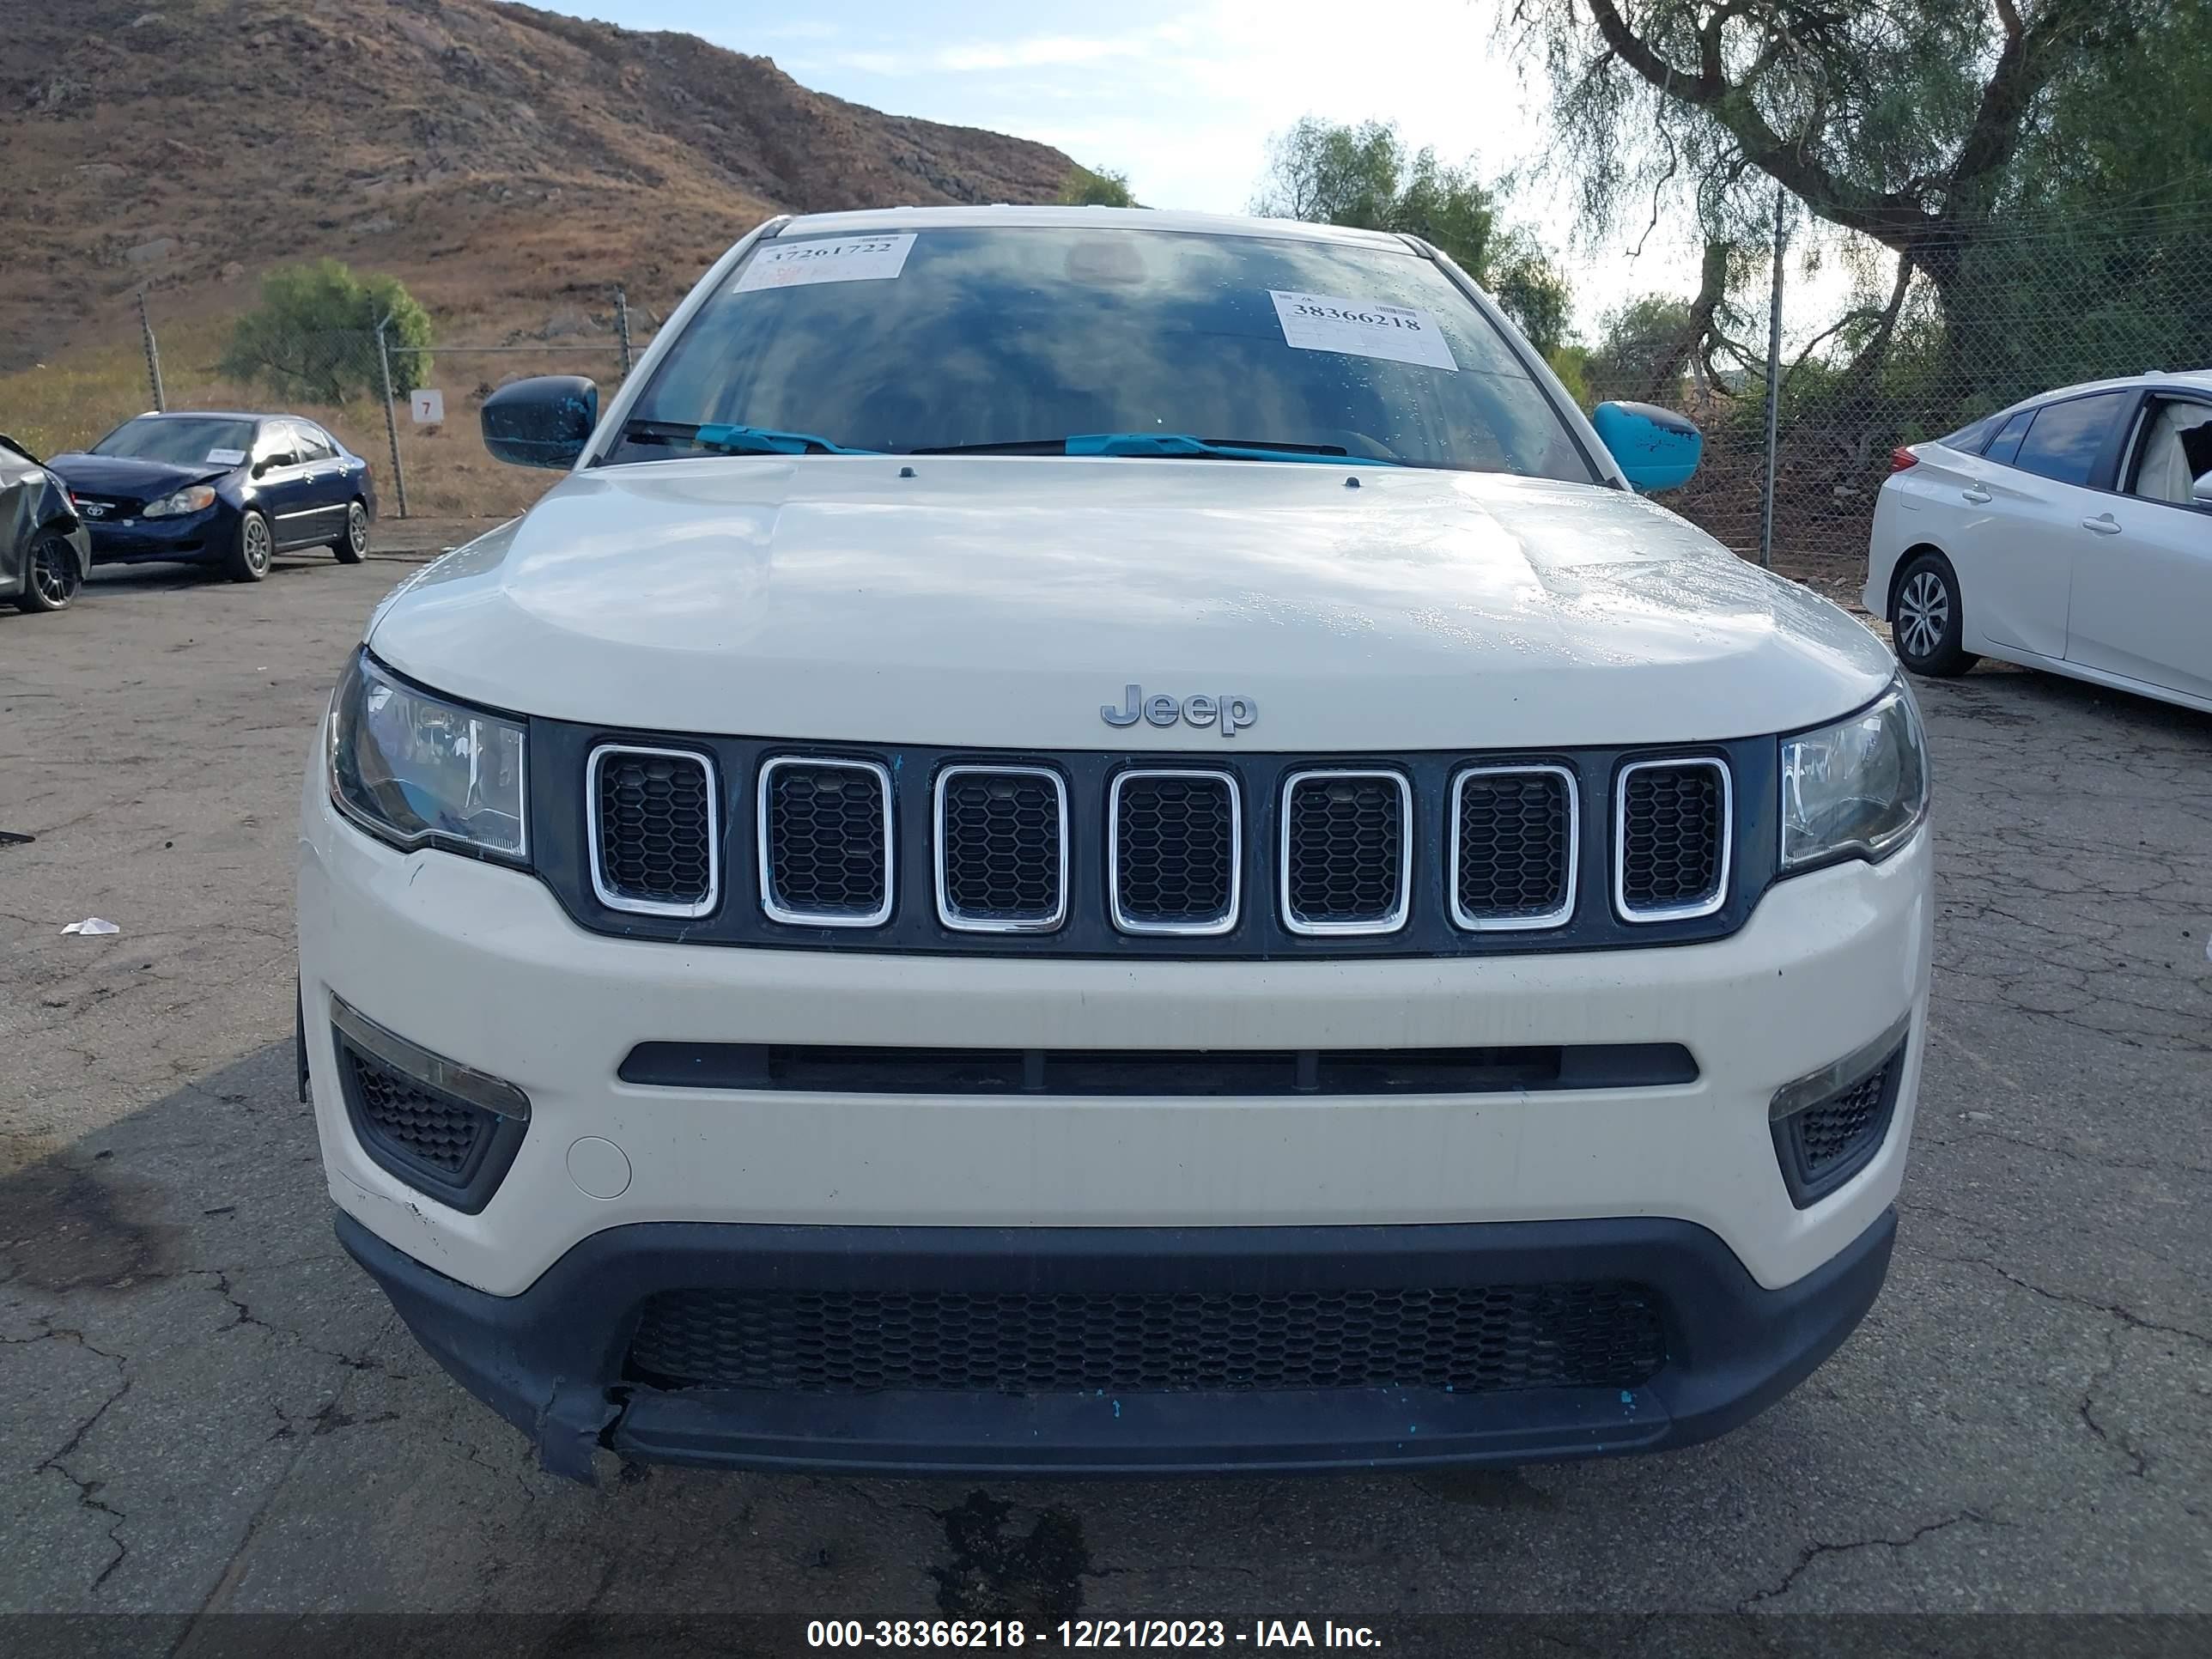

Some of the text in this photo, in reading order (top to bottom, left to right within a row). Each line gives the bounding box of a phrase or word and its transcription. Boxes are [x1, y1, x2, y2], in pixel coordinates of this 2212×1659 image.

[1292, 304, 1422, 331] 38366218
[422, 402, 431, 414] 7
[1100, 684, 1258, 738] Jeep
